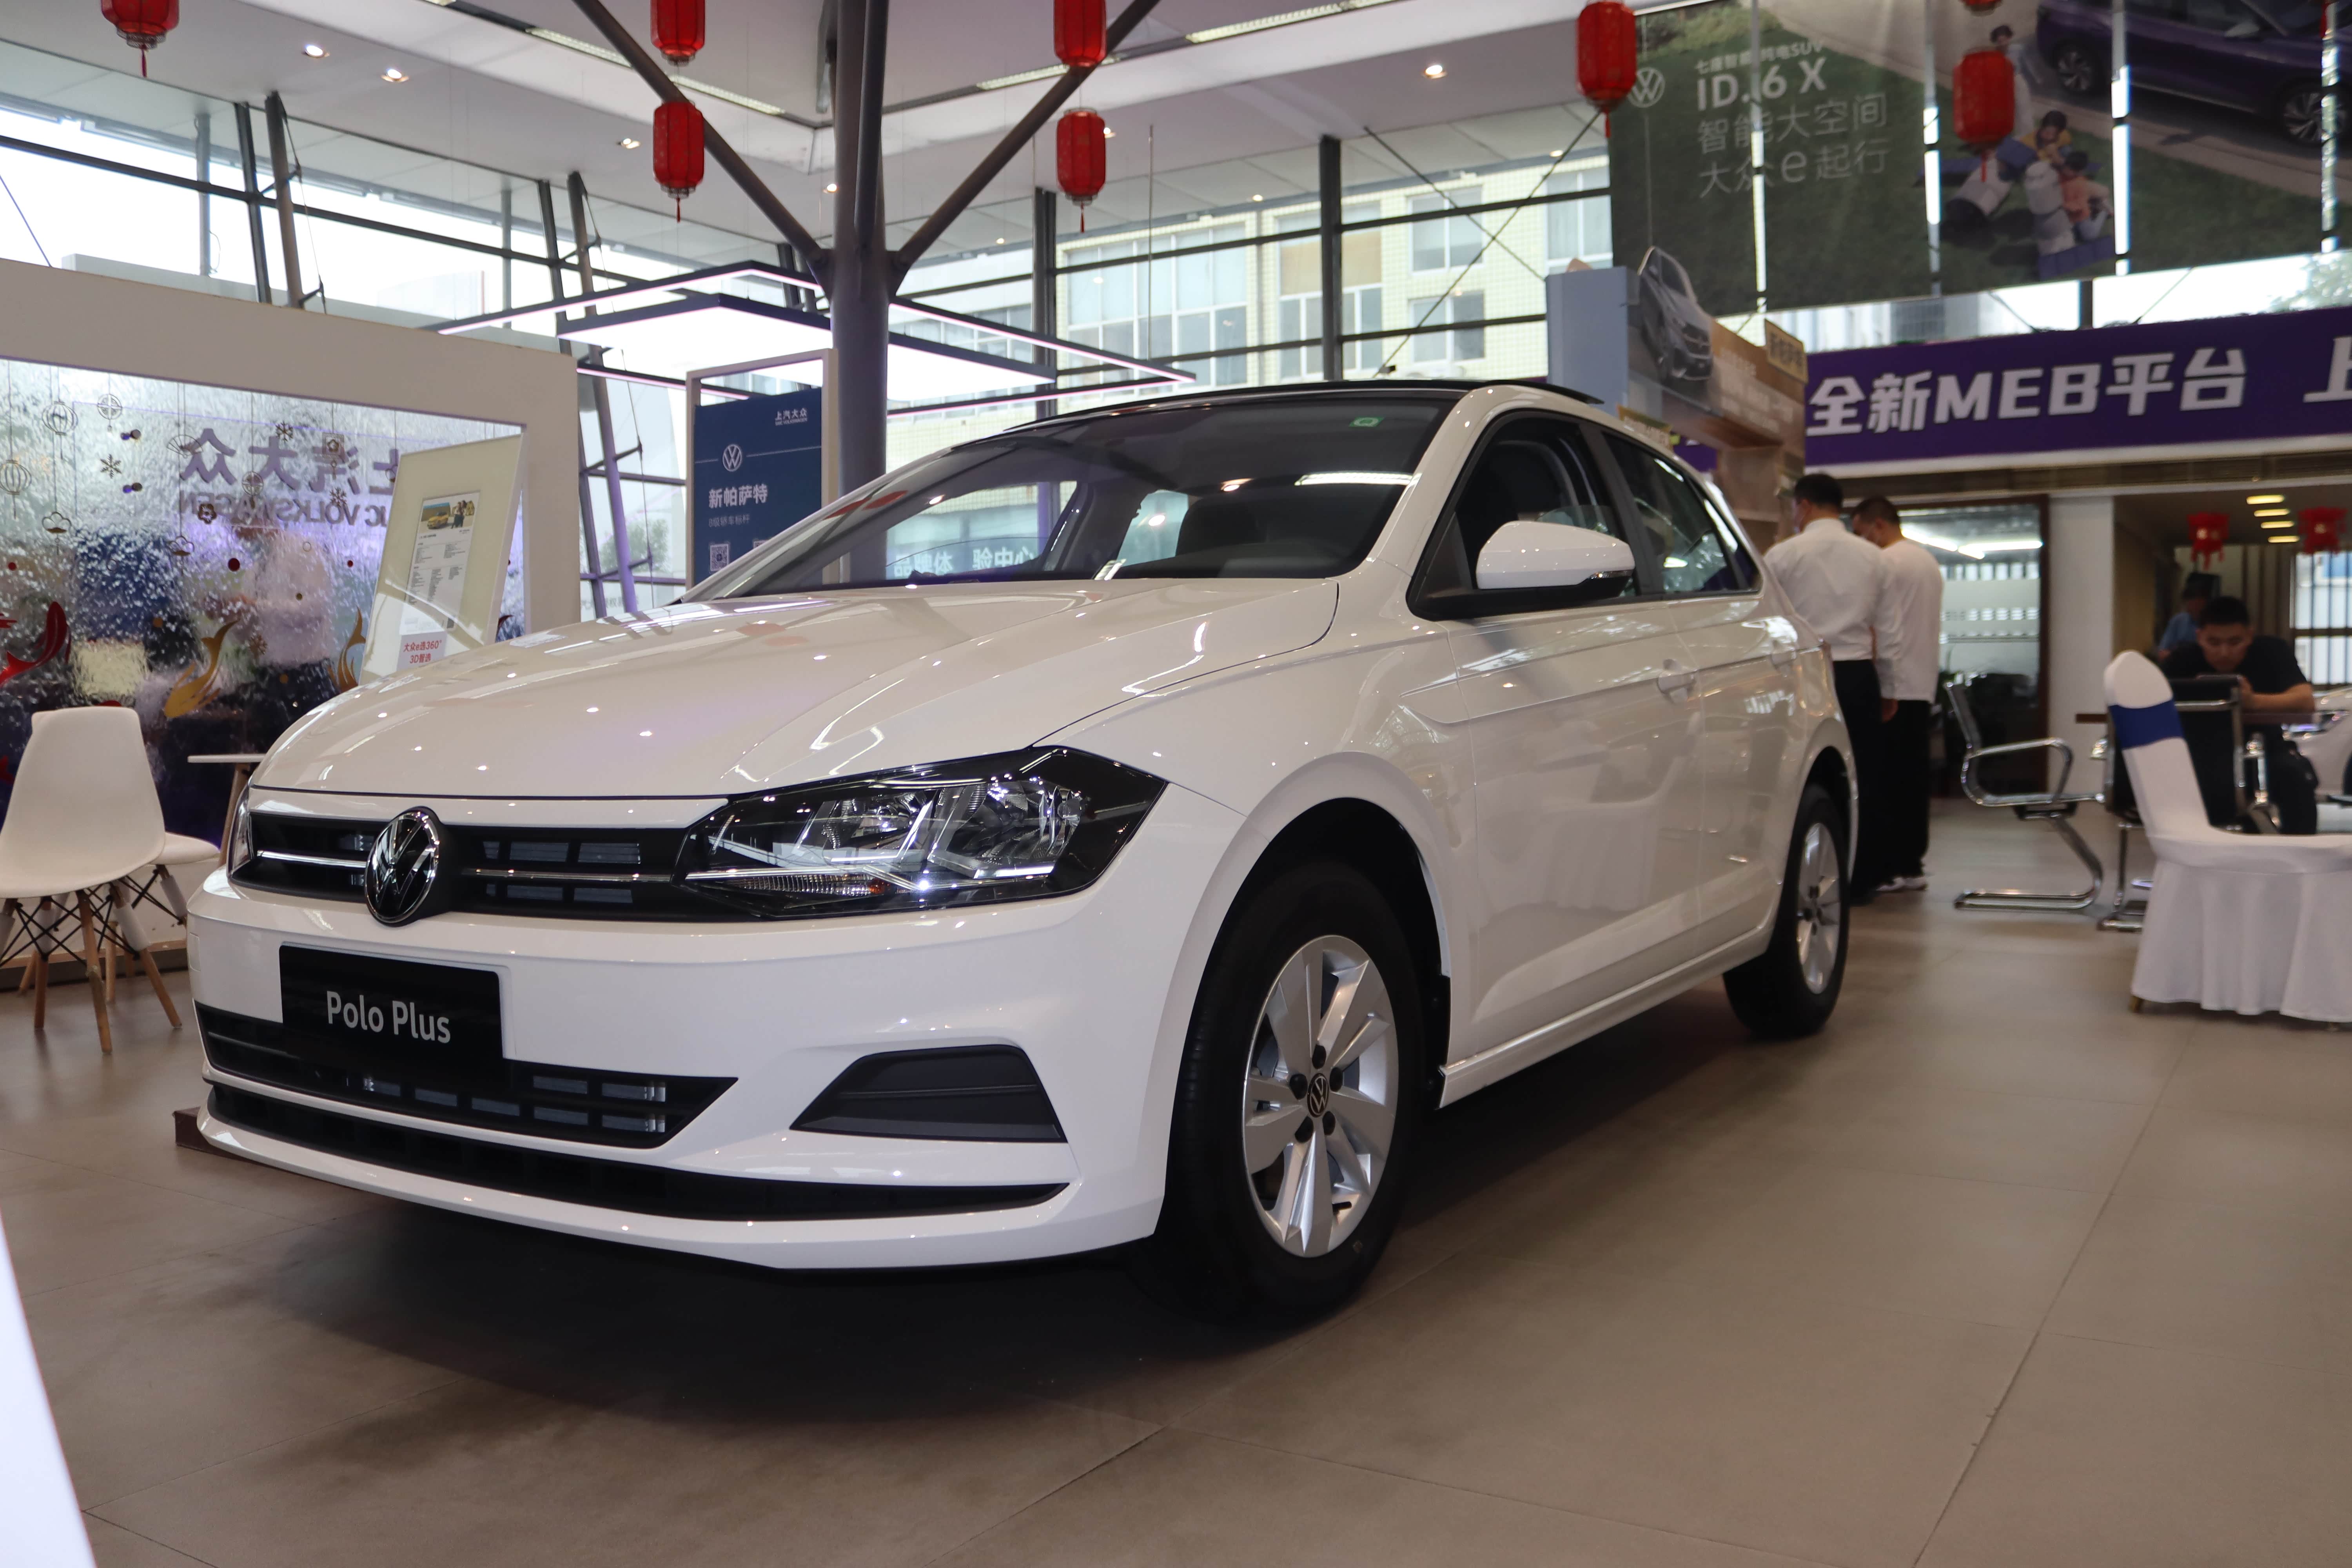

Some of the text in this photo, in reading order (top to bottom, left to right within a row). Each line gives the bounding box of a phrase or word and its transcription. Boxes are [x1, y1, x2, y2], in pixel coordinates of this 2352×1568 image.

[1697, 57, 1827, 111] ID.6 X
[1697, 93, 1888, 154] 智能大空间
[1699, 137, 1893, 198] 大众e起行
[1806, 347, 2246, 437] 全新MEB平台
[708, 483, 768, 508] 新帕萨特
[327, 991, 451, 1044] Polo Plus
